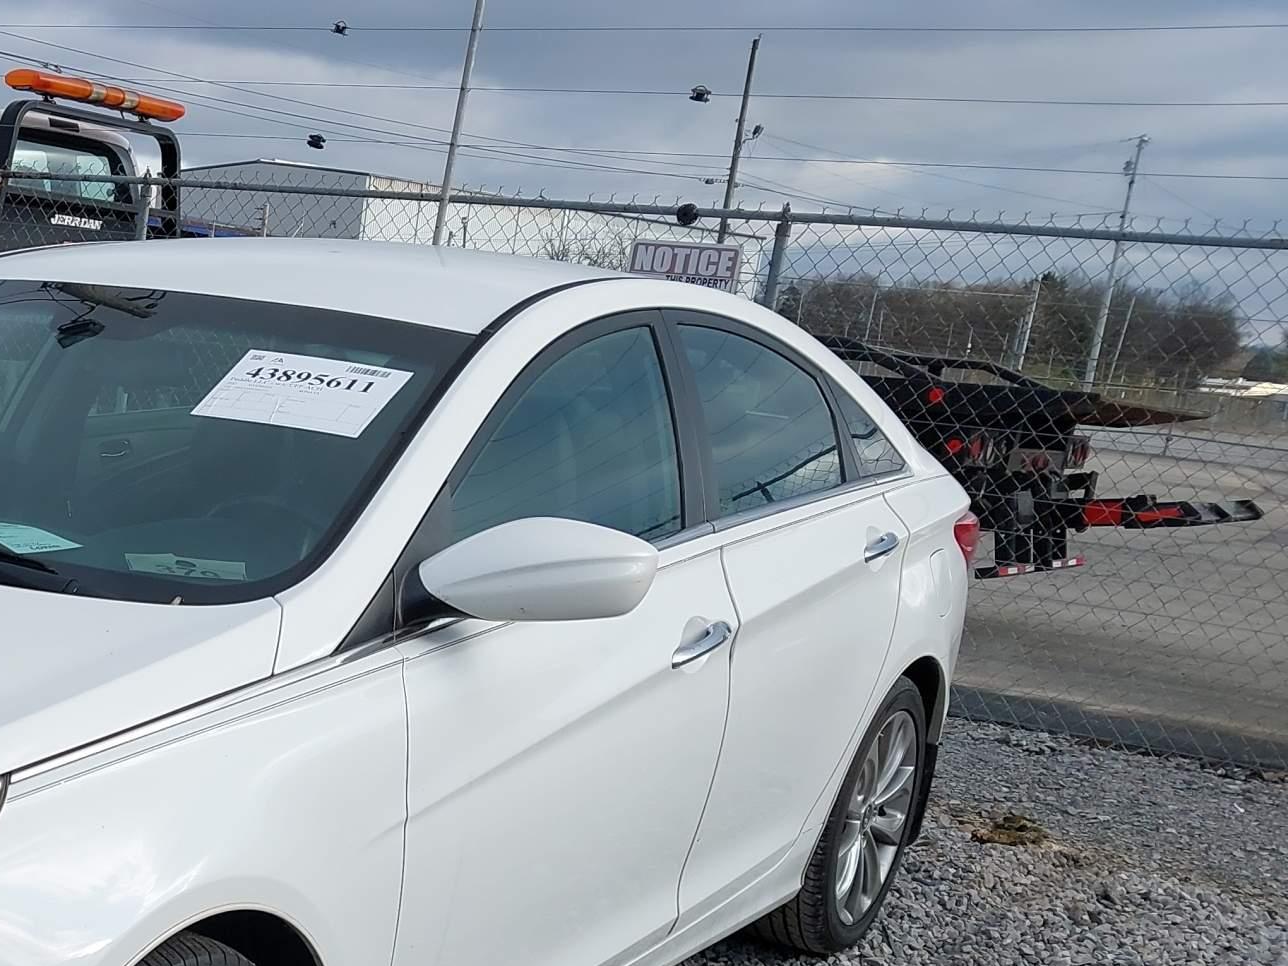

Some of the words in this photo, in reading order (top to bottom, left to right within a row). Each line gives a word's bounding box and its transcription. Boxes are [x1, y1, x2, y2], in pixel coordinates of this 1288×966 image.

[634, 245, 735, 277] NOTICE
[685, 276, 730, 289] PROPERTY
[246, 367, 375, 393] 43895611
